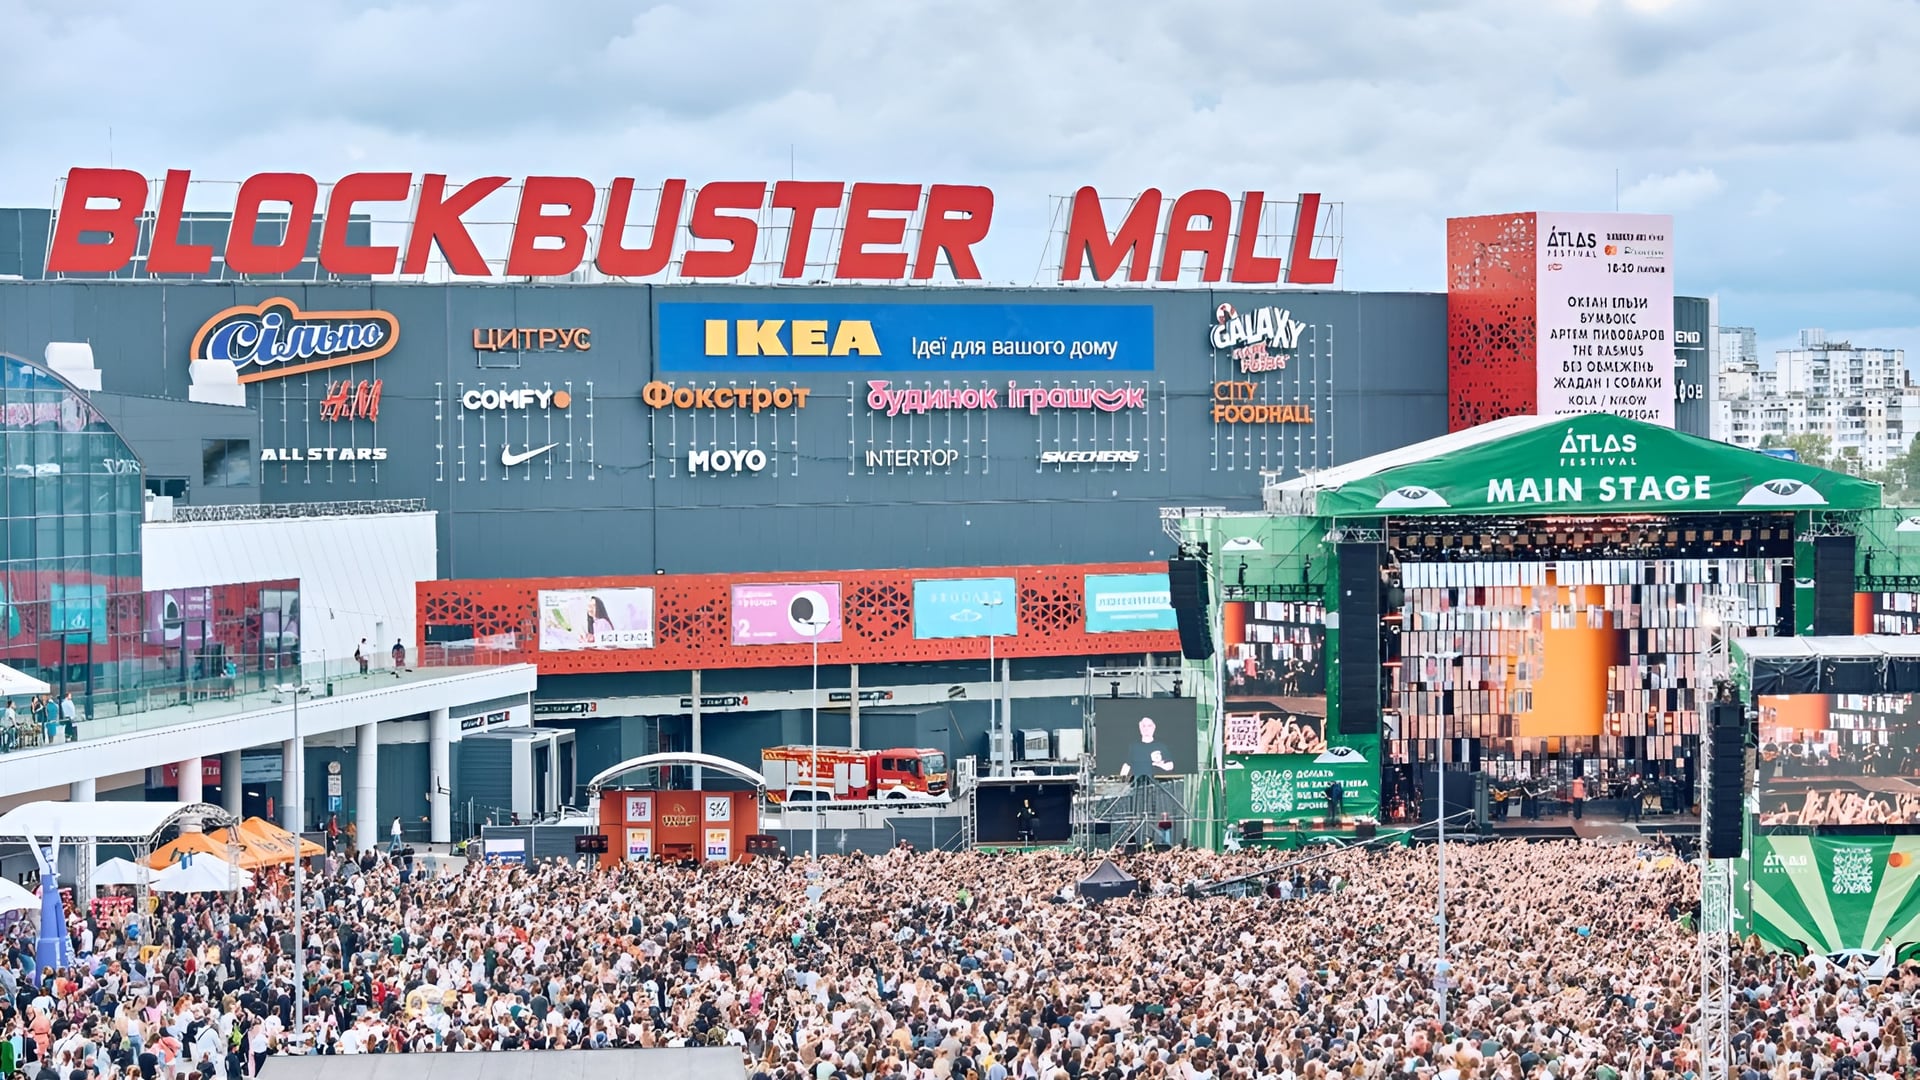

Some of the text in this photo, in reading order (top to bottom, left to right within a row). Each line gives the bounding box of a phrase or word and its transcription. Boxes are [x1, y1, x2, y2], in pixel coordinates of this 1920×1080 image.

[47, 167, 1338, 284] BLOCKBUSTER MALL
[705, 319, 882, 356] IKEA
[1211, 306, 1306, 349] GALAXY
[206, 313, 384, 371] Сільпо
[473, 328, 592, 351] ЦИТРУС
[912, 336, 1118, 360] Ідеї для вашого дому
[1573, 345, 1644, 356] THE RASMUS
[1214, 381, 1258, 401] CITY
[1554, 377, 1601, 389] ЖАДАН
[1614, 377, 1662, 389] СОБАКИ
[463, 390, 554, 410] COMFY
[642, 380, 811, 414] Фокстрот
[867, 380, 998, 416] будинок
[1214, 404, 1313, 423] FOODHALL
[1560, 428, 1637, 453] ÁTLAS
[261, 448, 387, 460] ALL STARS
[688, 449, 767, 472] MOYO
[866, 450, 958, 467] INTERTOP
[1041, 451, 1140, 463] SKECHERS
[1560, 457, 1637, 467] FESTIVAL
[1487, 475, 1711, 503] MAIN STAGE
